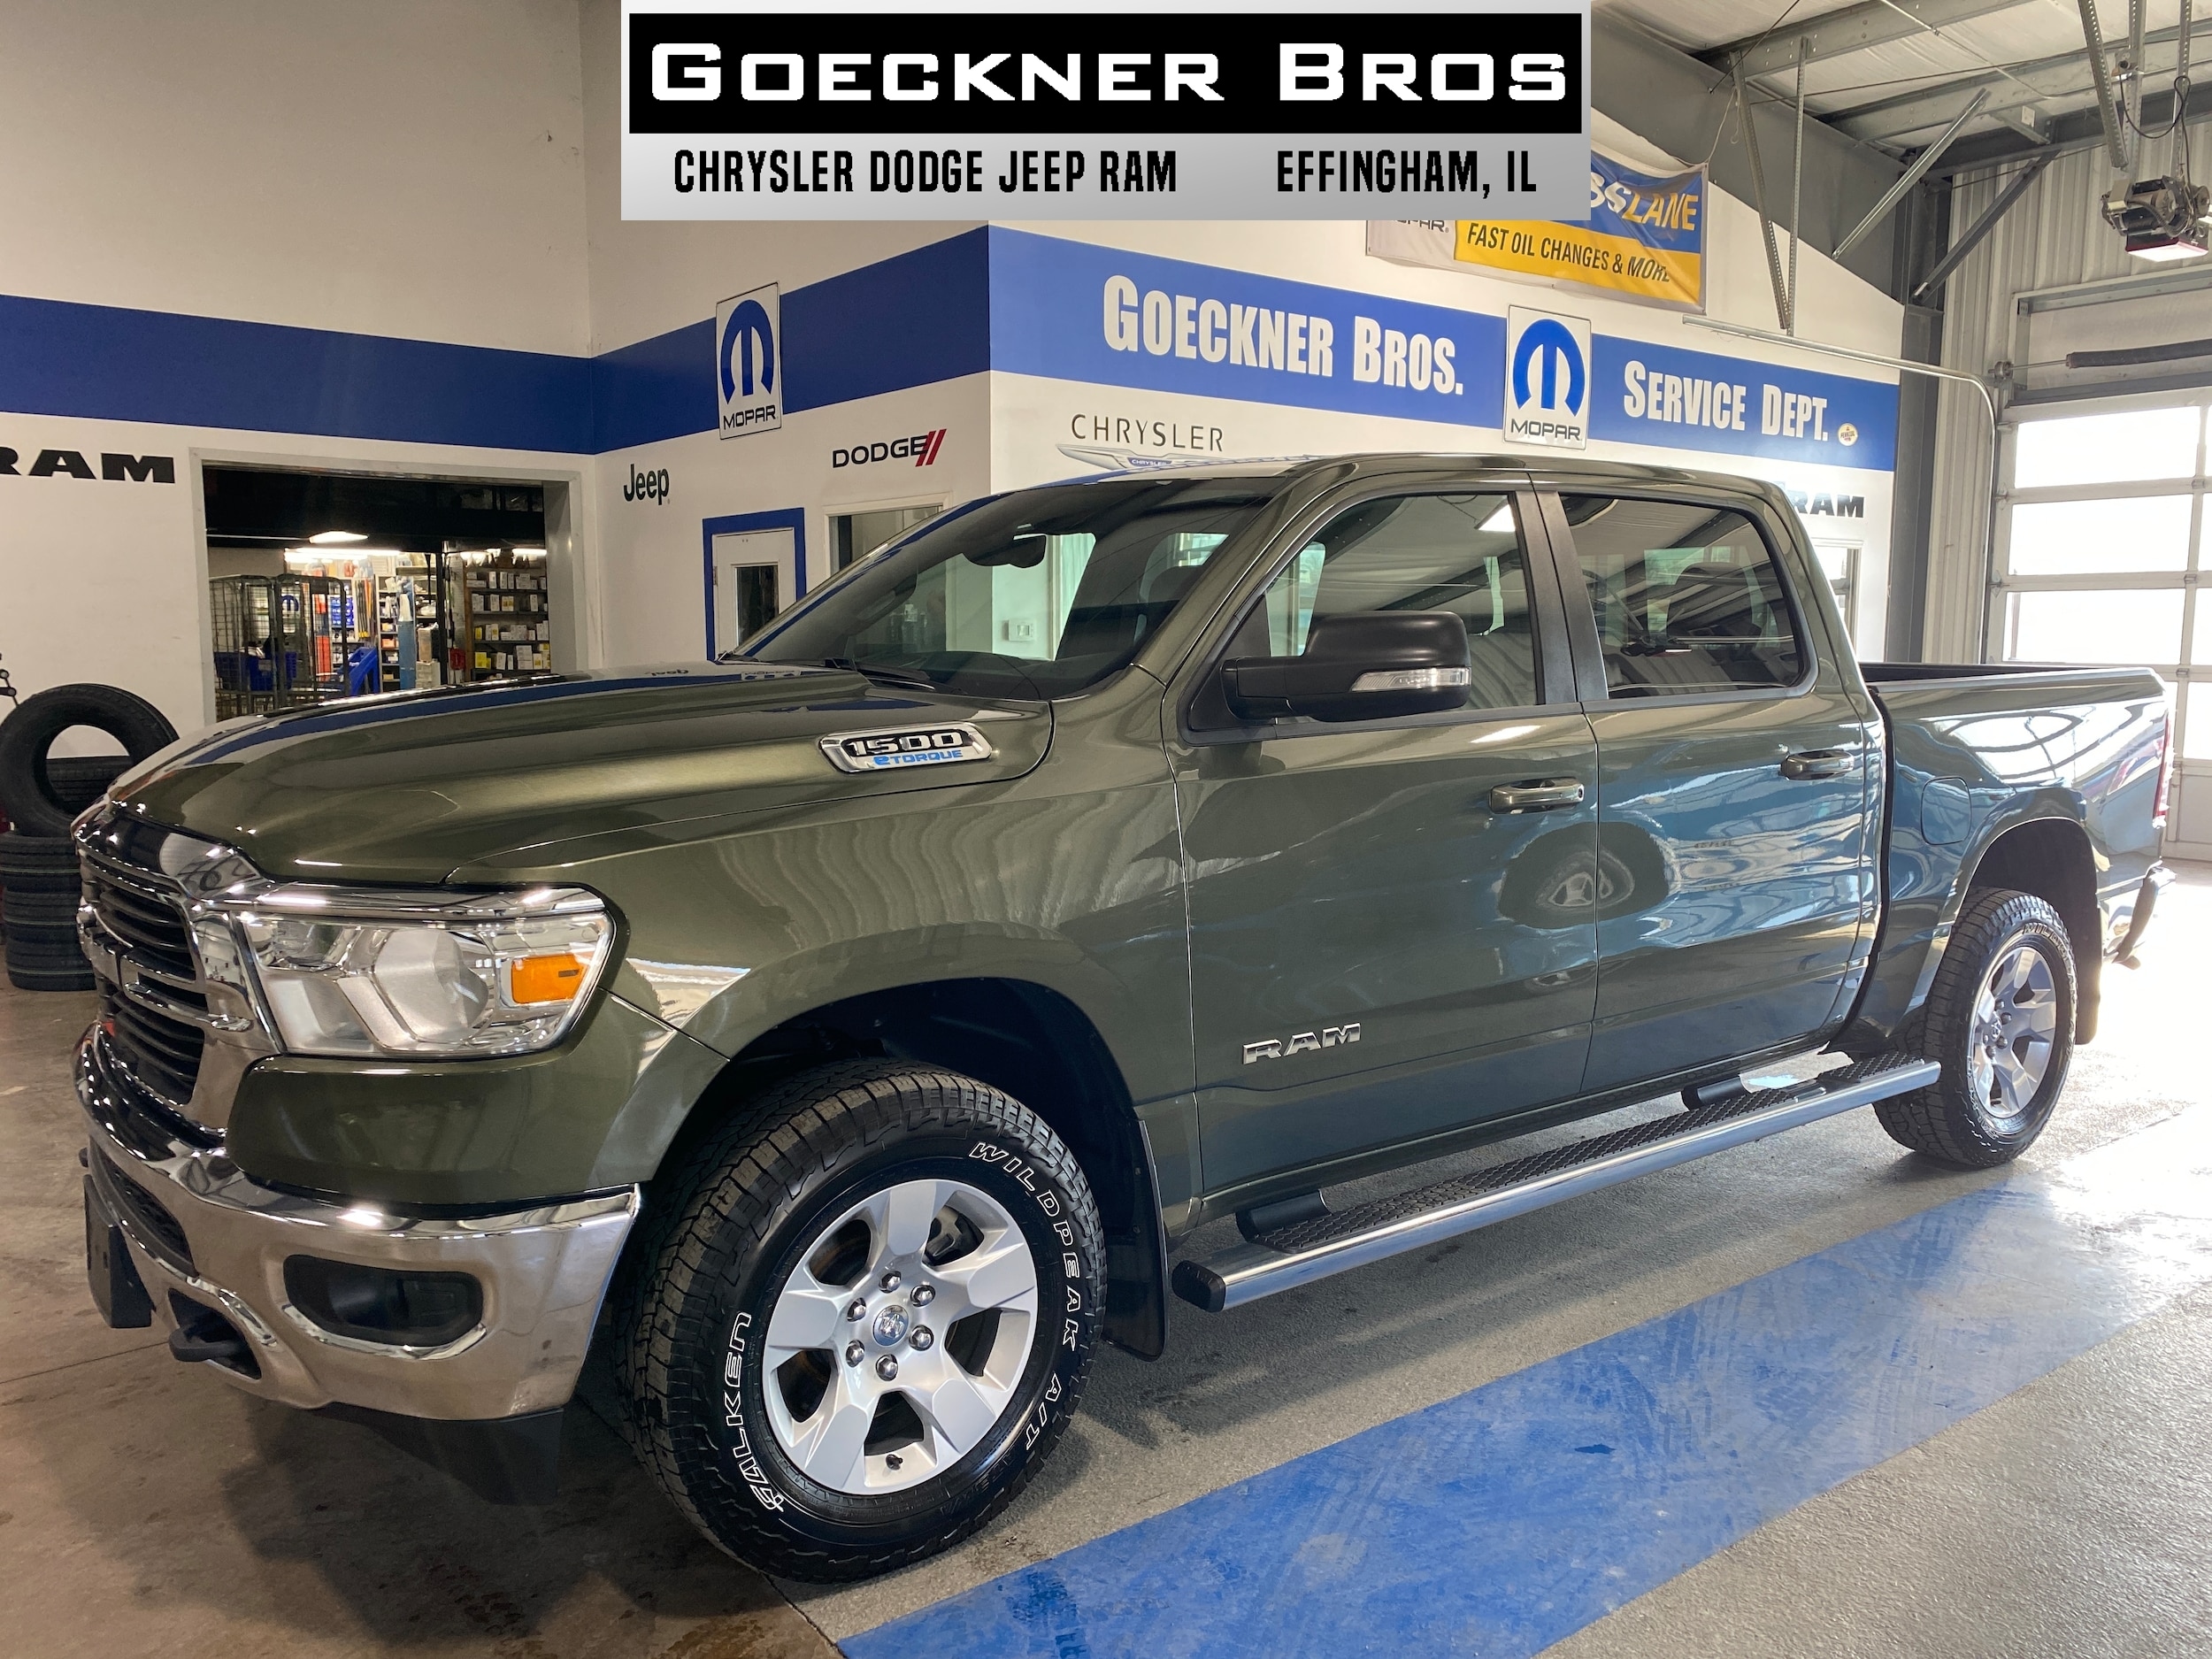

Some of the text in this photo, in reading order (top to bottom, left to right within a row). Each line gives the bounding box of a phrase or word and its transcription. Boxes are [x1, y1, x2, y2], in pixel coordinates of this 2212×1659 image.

[1467, 222, 1509, 251] FAST
[1511, 231, 1536, 257] OIL
[1540, 237, 1609, 271] CHANGES
[1612, 253, 1624, 274] &
[723, 404, 776, 431] MOPAR
[1071, 413, 1223, 452] CHRYSLER
[1510, 418, 1581, 442] MOPAR
[832, 434, 929, 468] DODGE
[623, 464, 670, 505] Jeep
[849, 732, 964, 756] 1500
[1243, 1023, 1361, 1064] RAM
[969, 1141, 1081, 1351] WILDPEAK
[725, 1311, 784, 1512] FALKEN
